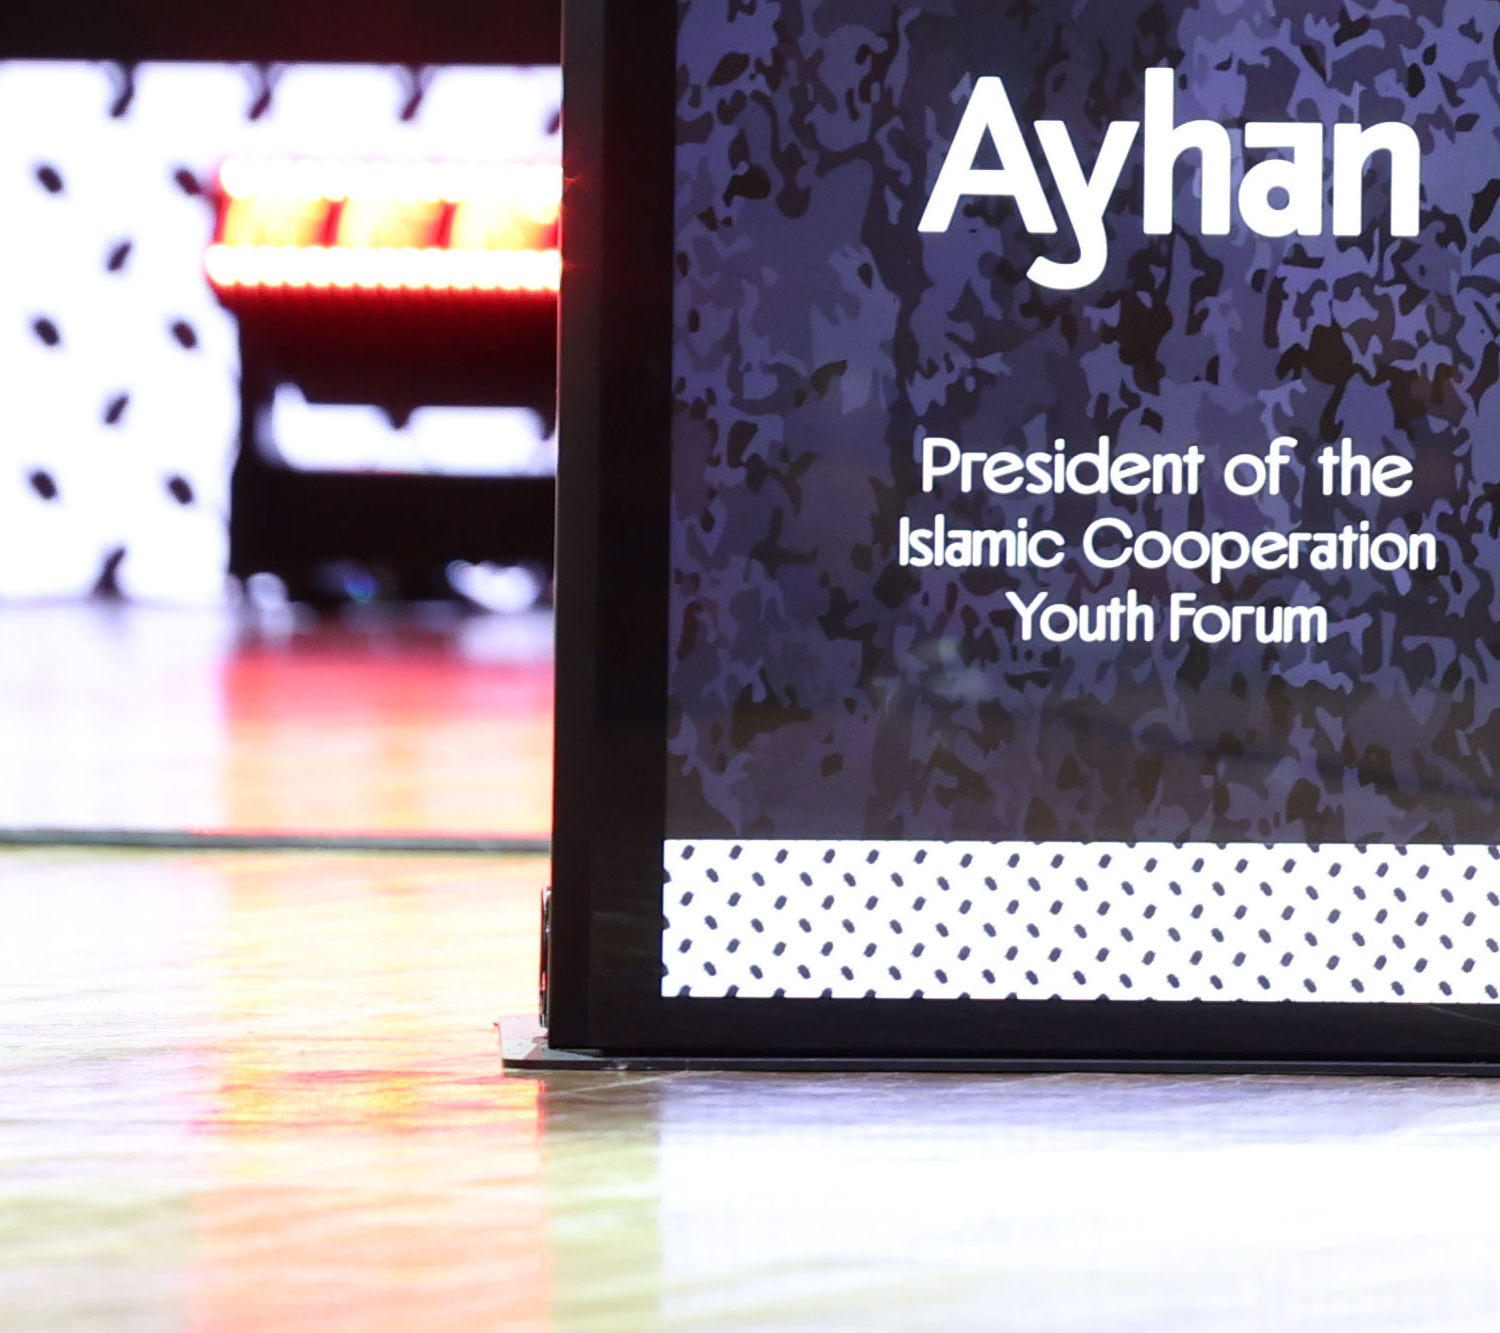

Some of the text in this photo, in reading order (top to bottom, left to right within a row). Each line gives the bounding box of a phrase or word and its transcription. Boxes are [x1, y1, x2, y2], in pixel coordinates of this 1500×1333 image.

[917, 67, 1421, 290] Ayhan
[922, 435, 1413, 497] President of the
[899, 513, 1436, 584] Islamic Cooperation
[1005, 588, 1328, 644] Youth Forum
